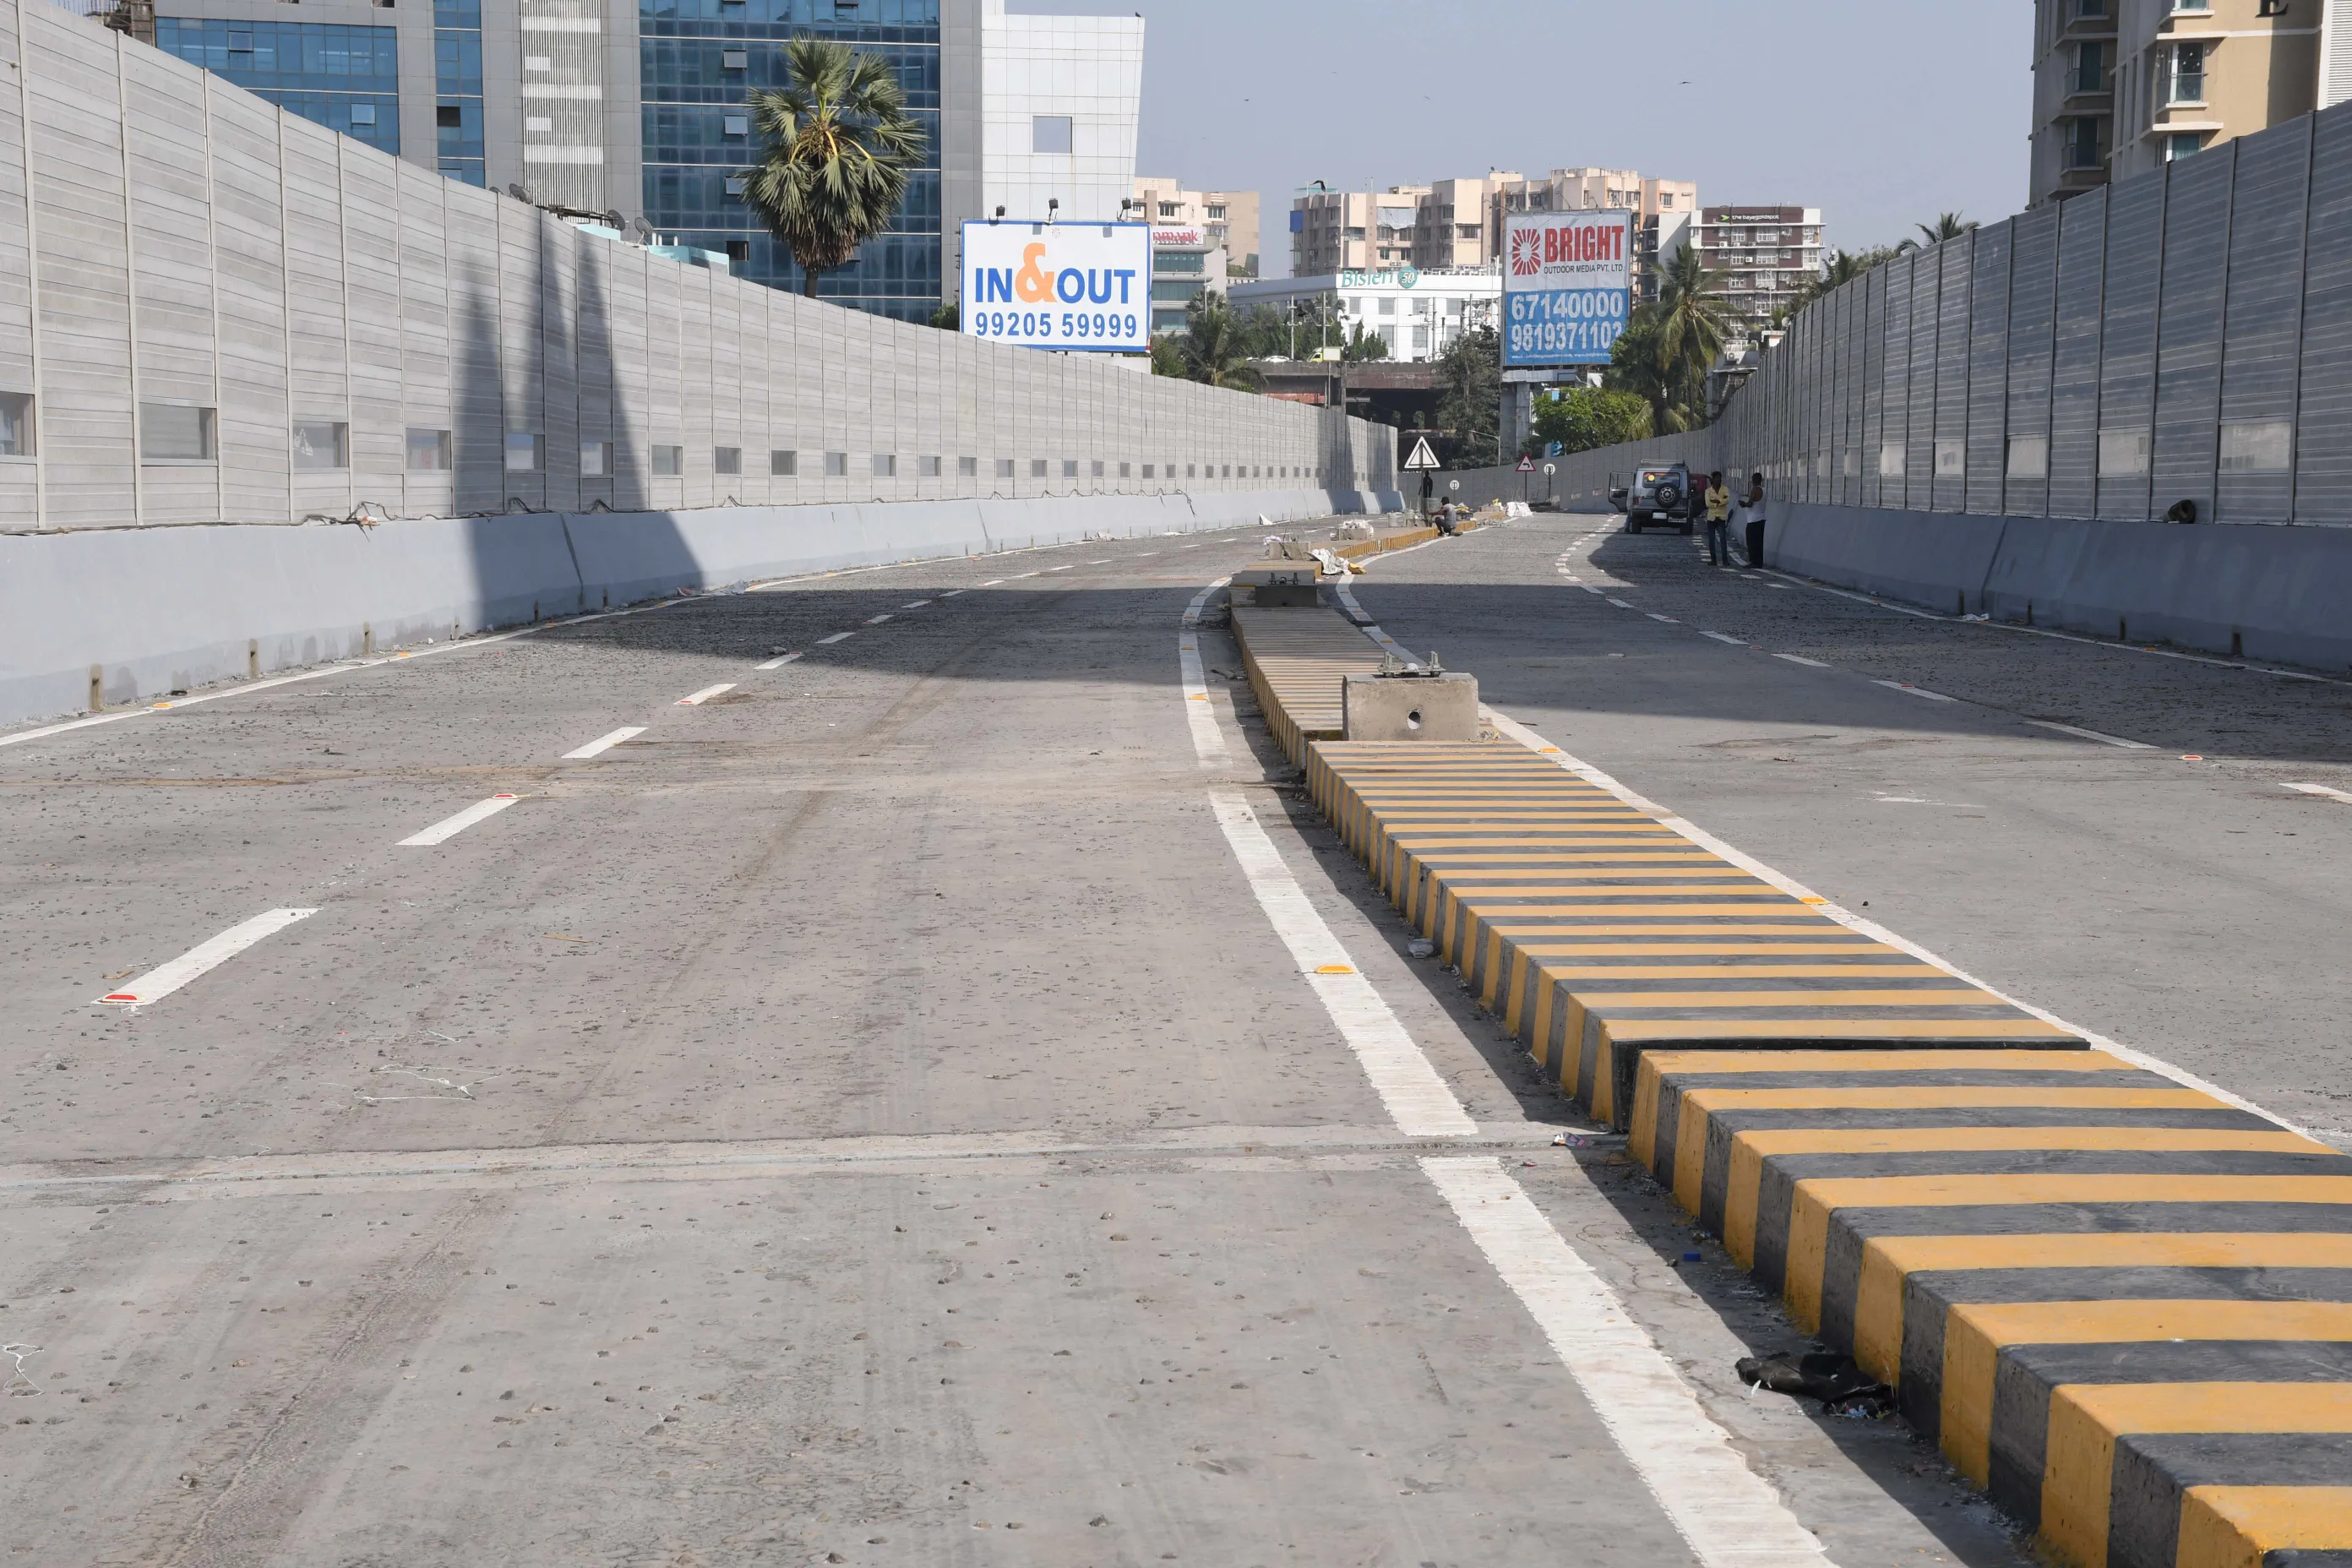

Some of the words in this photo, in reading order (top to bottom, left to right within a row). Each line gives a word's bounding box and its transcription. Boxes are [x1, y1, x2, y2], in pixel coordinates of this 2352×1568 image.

[1544, 226, 1625, 263] BRIGHT
[1342, 267, 1394, 287] Bisleri
[1544, 265, 1575, 275] OUTDOOR
[1576, 264, 1595, 273] MEDIA
[1596, 264, 1609, 272] PVT.
[1511, 291, 1623, 320] 67140000
[975, 312, 1052, 337] 99205
[1061, 313, 1137, 338] 59999
